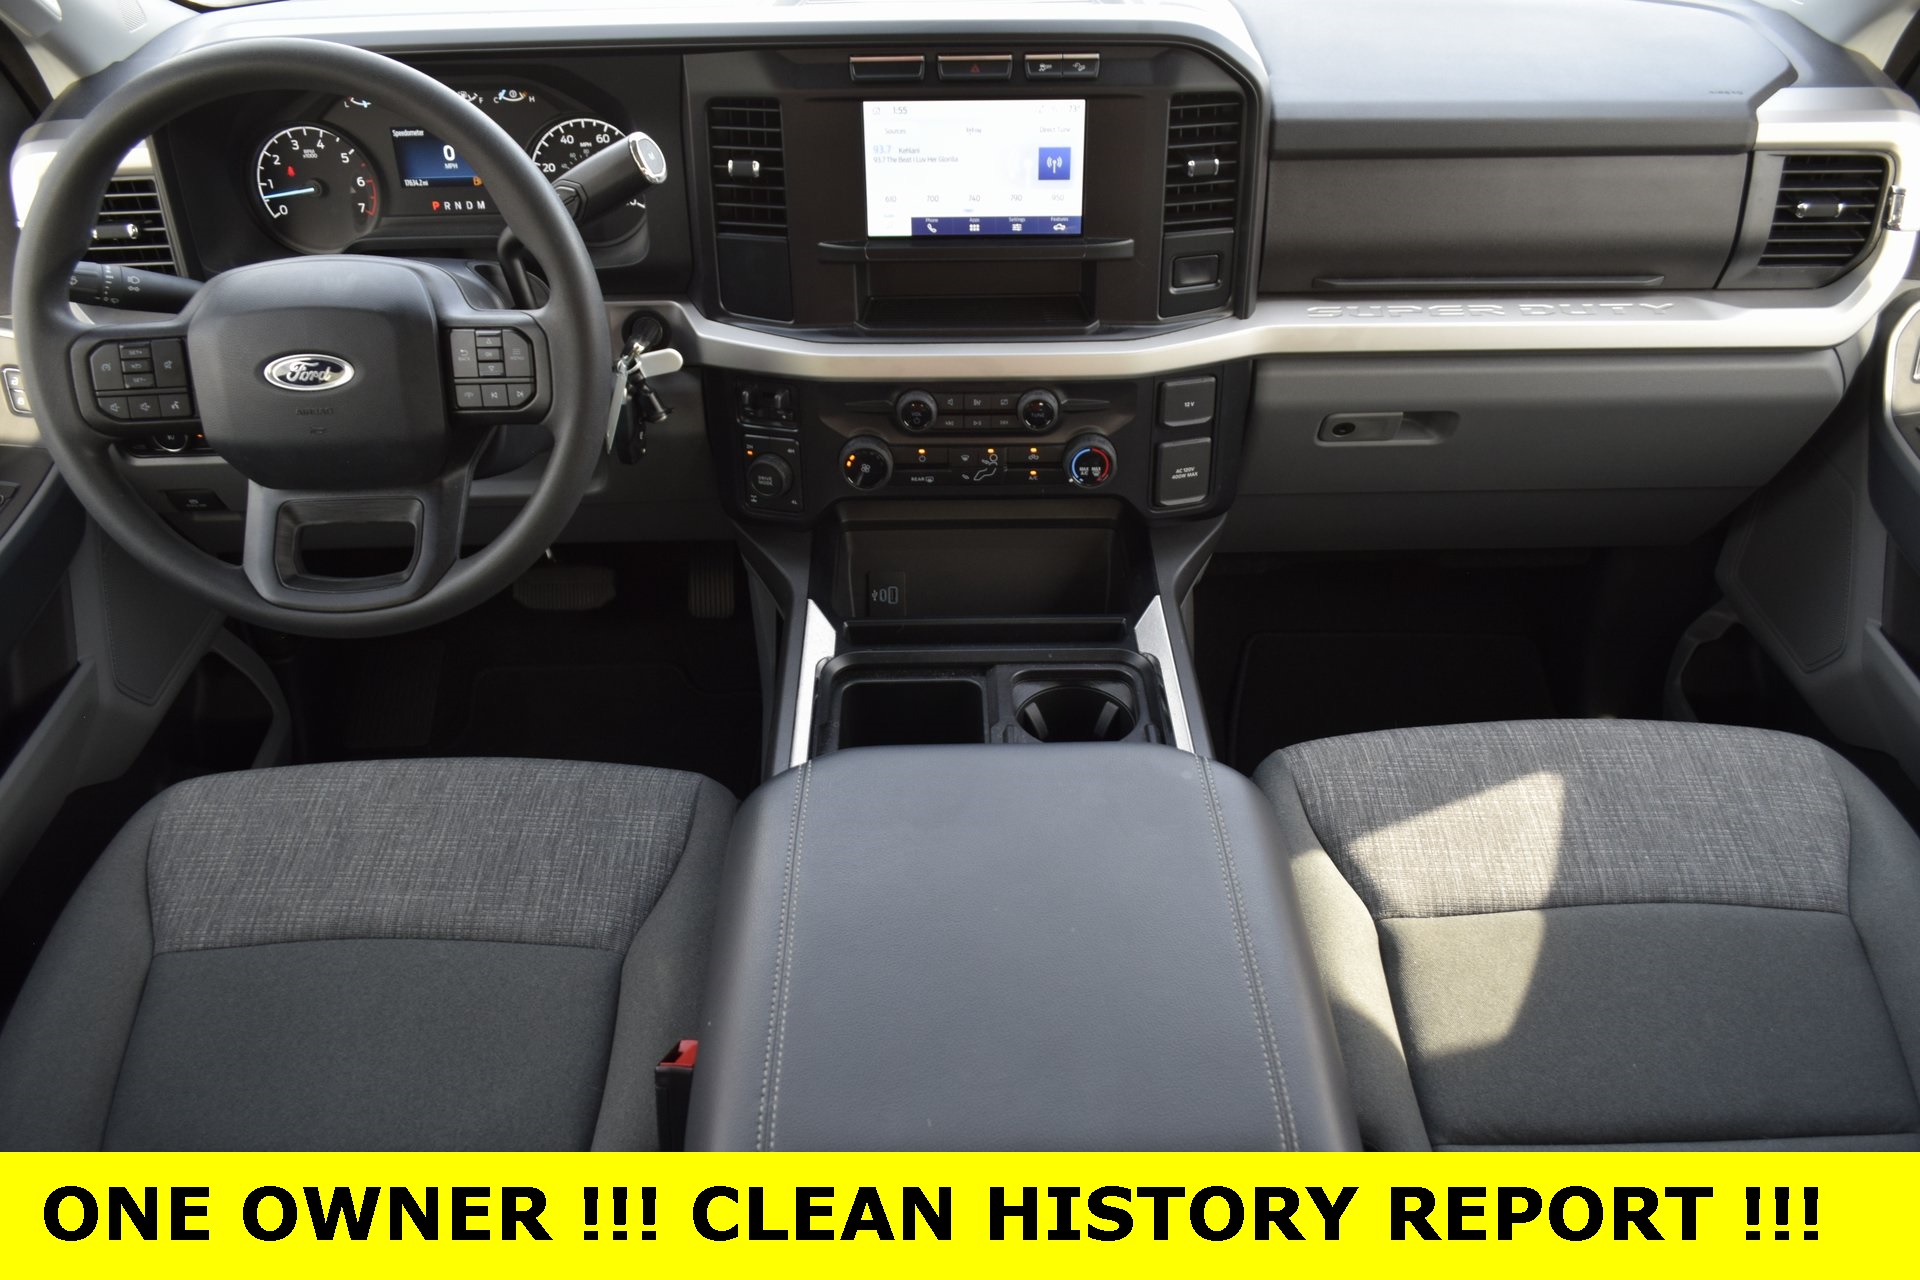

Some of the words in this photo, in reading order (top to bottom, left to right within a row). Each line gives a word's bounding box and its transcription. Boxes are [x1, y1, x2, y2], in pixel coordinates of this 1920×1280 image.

[893, 106, 908, 115] 1:55
[392, 130, 424, 138] Speedometer
[596, 134, 610, 143] 60
[291, 139, 299, 150] 3
[317, 139, 325, 149] 4
[560, 135, 574, 144] 40
[443, 144, 456, 161] 0
[873, 145, 891, 154] 93.7
[272, 155, 281, 165] 2
[341, 153, 349, 163] 5
[542, 163, 556, 172] 20
[267, 179, 274, 189] 1
[356, 177, 365, 187] 6
[968, 194, 980, 202] 740
[1010, 193, 1022, 201] 790
[279, 205, 288, 215] 0
[358, 203, 365, 213] 7
[432, 201, 440, 210] P
[444, 201, 451, 210] R
[454, 201, 462, 210] N
[466, 200, 473, 210] D
[476, 200, 486, 210] M
[1306, 304, 1505, 318] SUPER
[1518, 302, 1673, 317] DUTY
[286, 361, 331, 382] Ford
